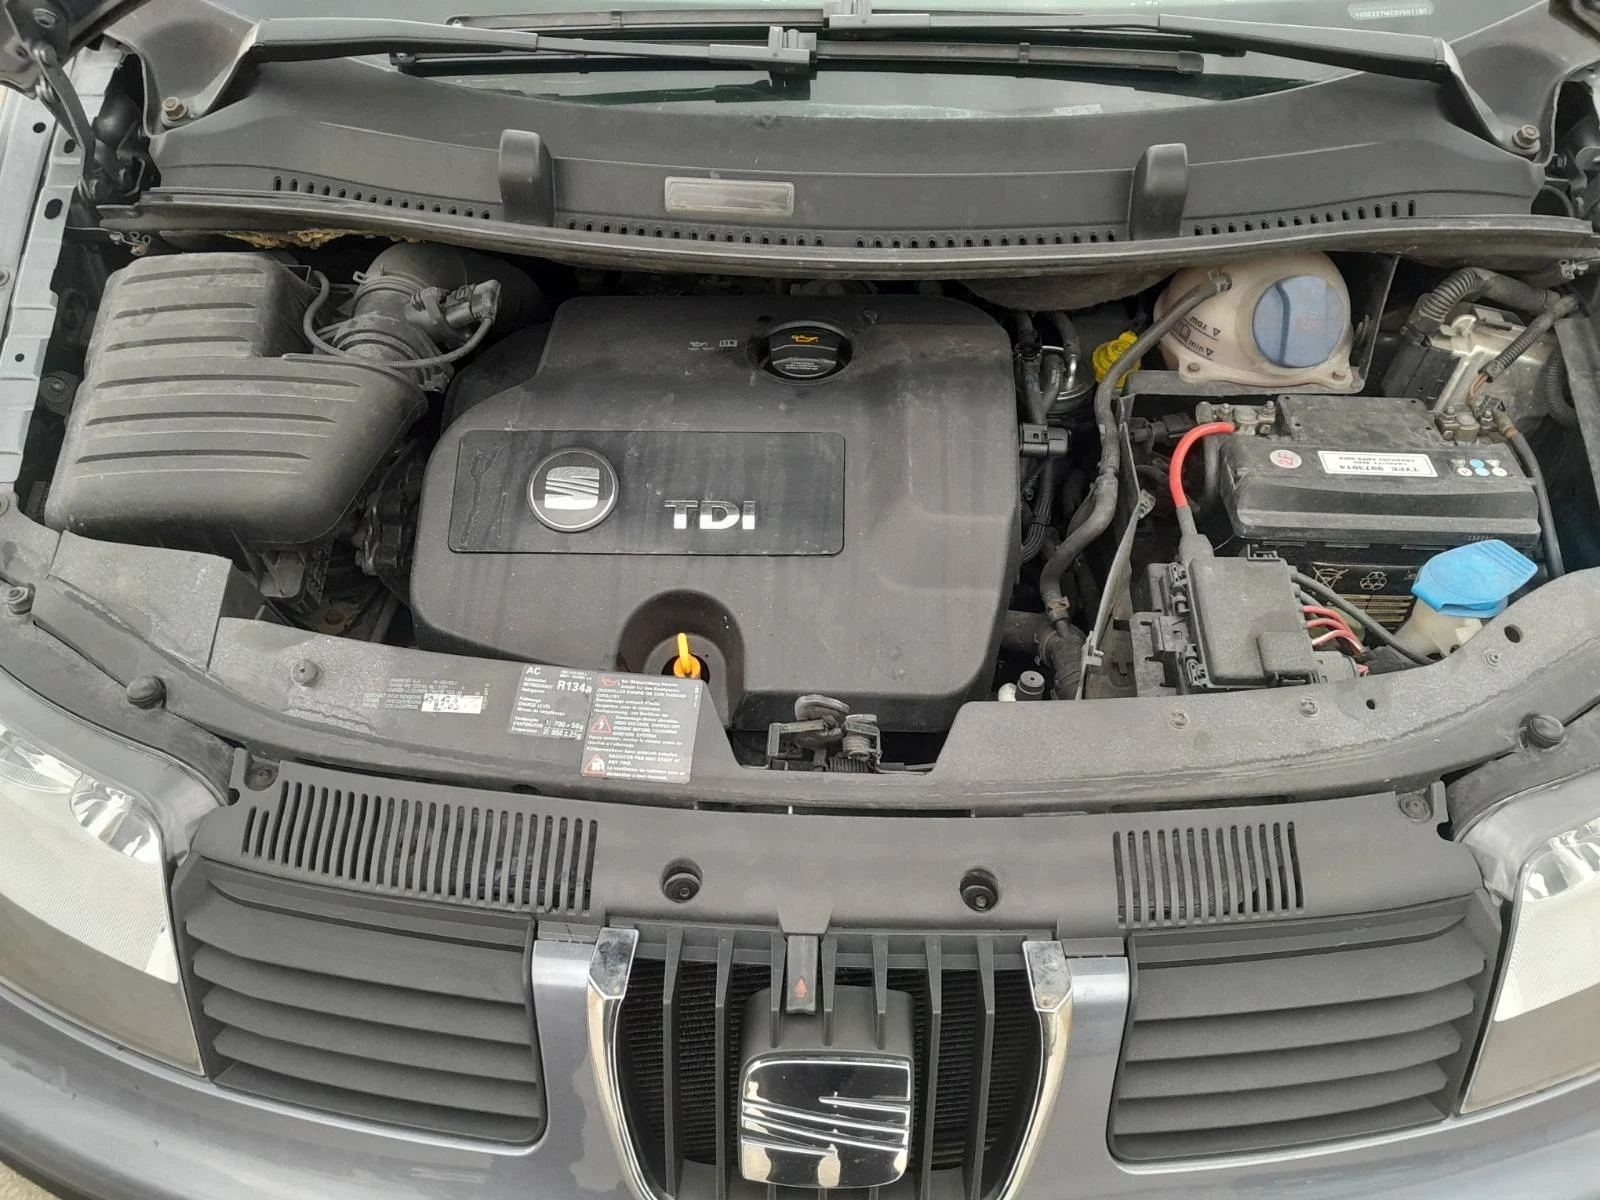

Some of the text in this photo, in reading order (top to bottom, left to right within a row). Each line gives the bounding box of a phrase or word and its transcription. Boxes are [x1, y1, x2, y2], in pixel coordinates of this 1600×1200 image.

[1189, 316, 1208, 330] max
[1188, 340, 1204, 353] min
[664, 500, 756, 530] TDI
[526, 666, 541, 675] AC
[557, 680, 592, 693] R134a
